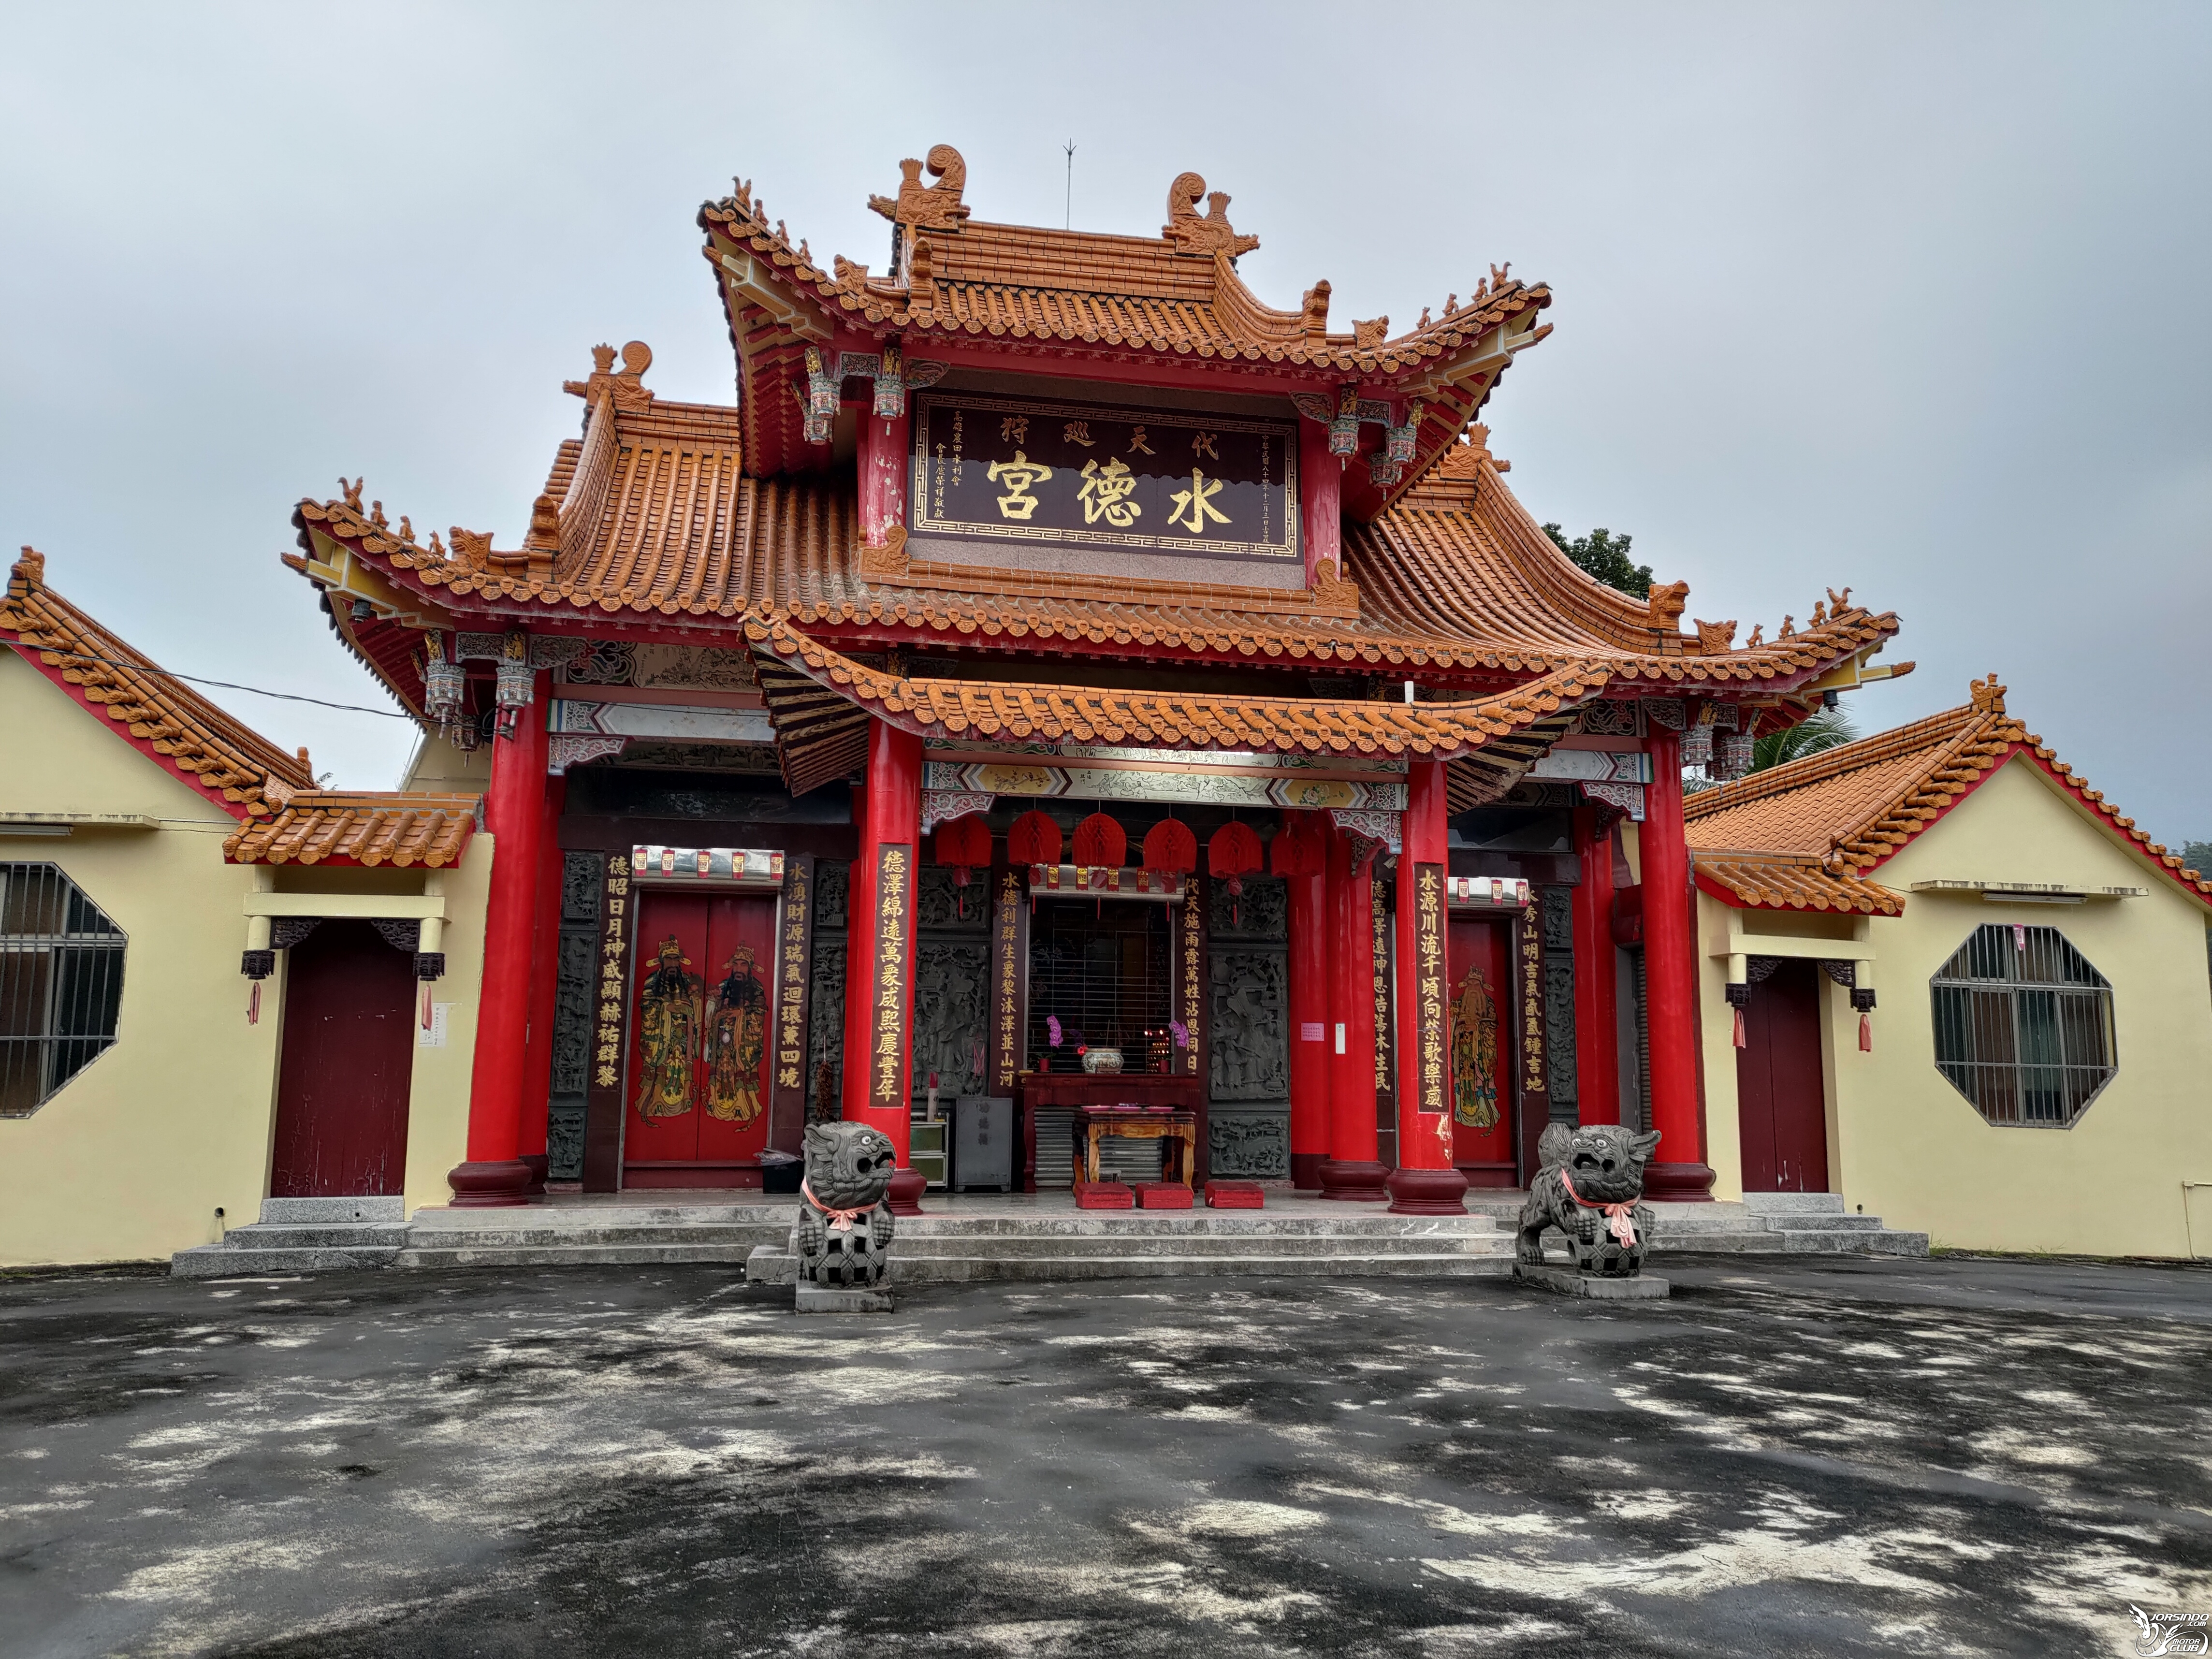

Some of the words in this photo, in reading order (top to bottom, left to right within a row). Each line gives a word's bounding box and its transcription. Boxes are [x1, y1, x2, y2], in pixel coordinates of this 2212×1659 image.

[987, 451, 1233, 533] 水德宮
[1183, 877, 1201, 1075] 代天施雨露萬姓沾恩同日
